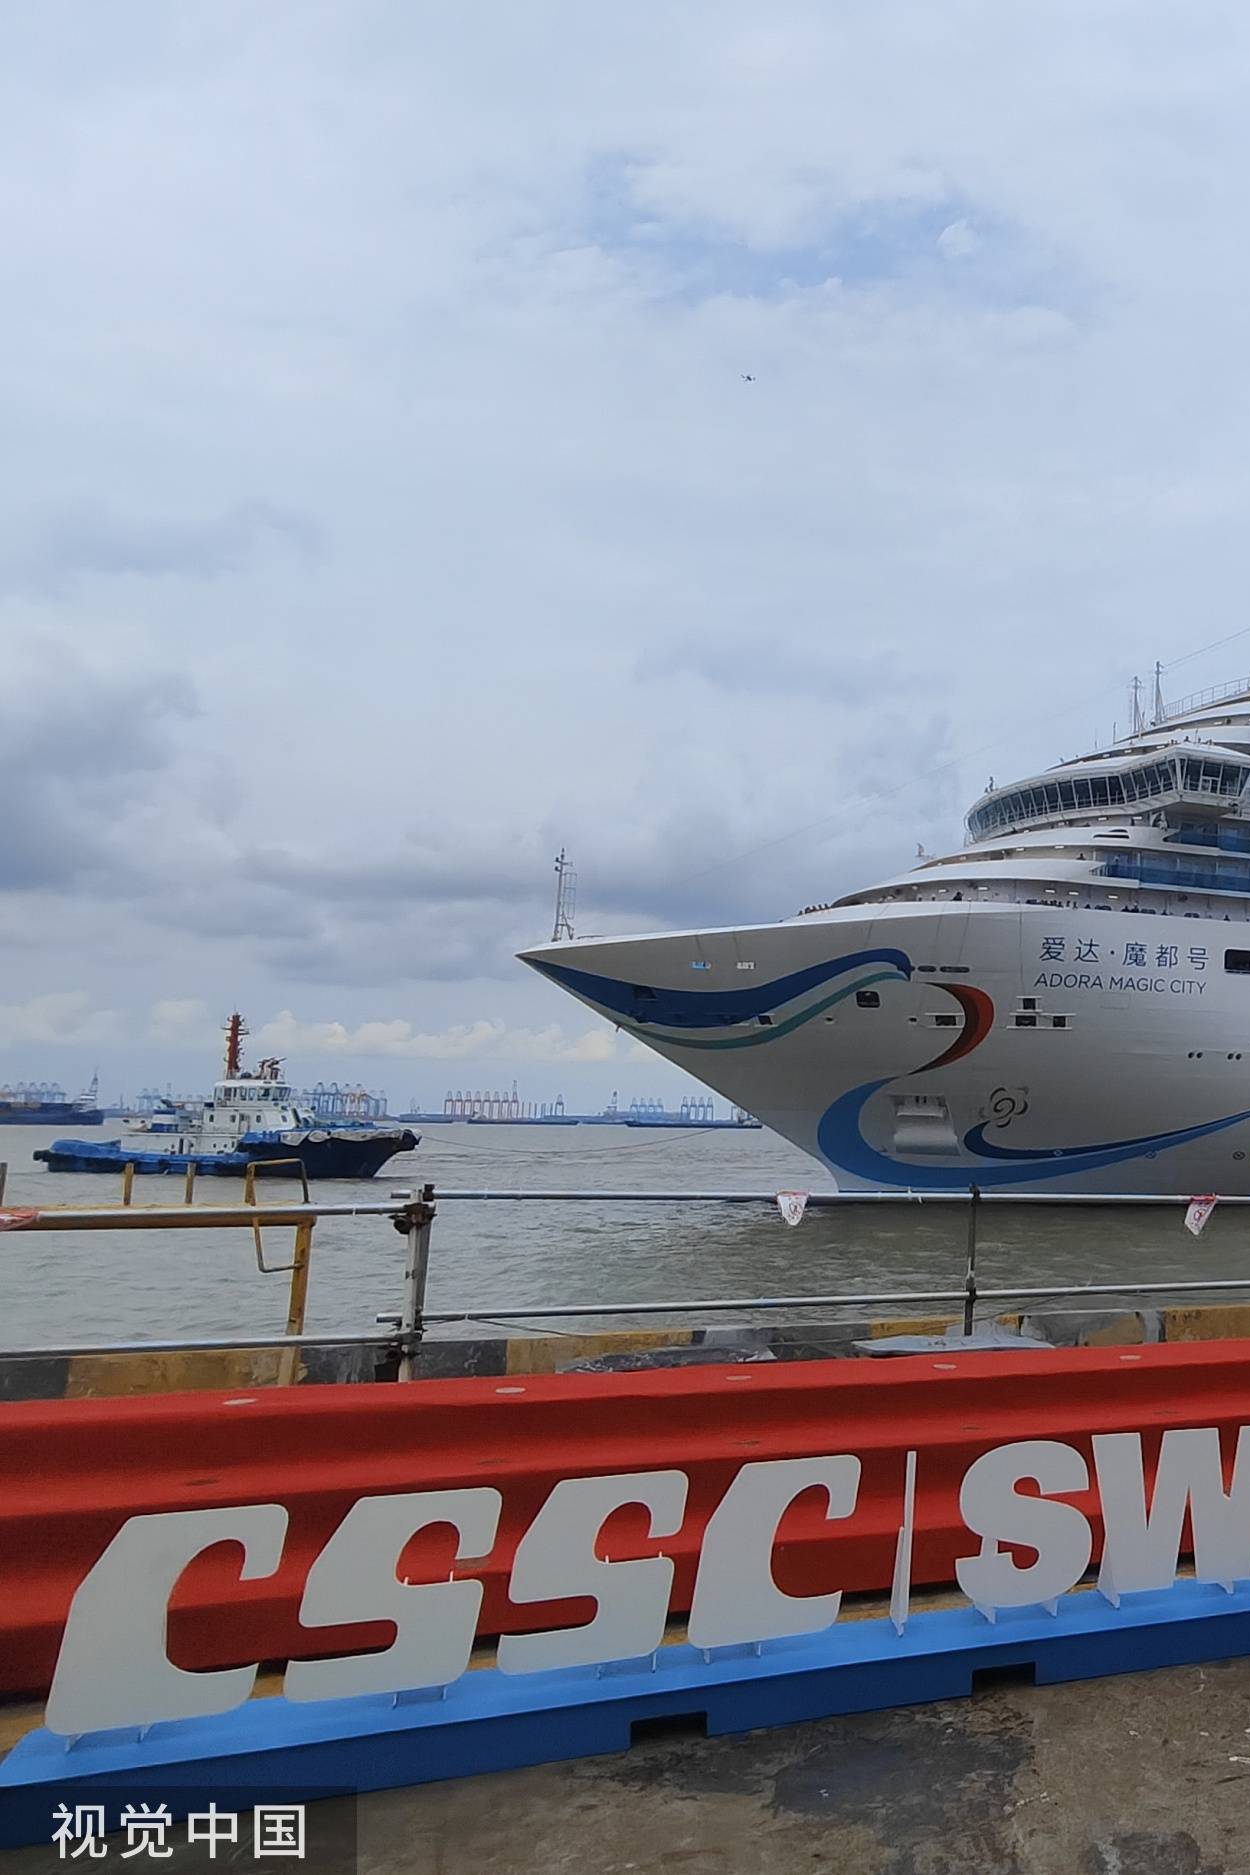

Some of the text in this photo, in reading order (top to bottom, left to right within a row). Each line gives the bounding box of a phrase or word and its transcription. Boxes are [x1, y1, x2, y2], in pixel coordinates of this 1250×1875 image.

[1034, 973, 1207, 995] ADORA MAGIC CITY
[44, 1455, 862, 1737] CSSC
